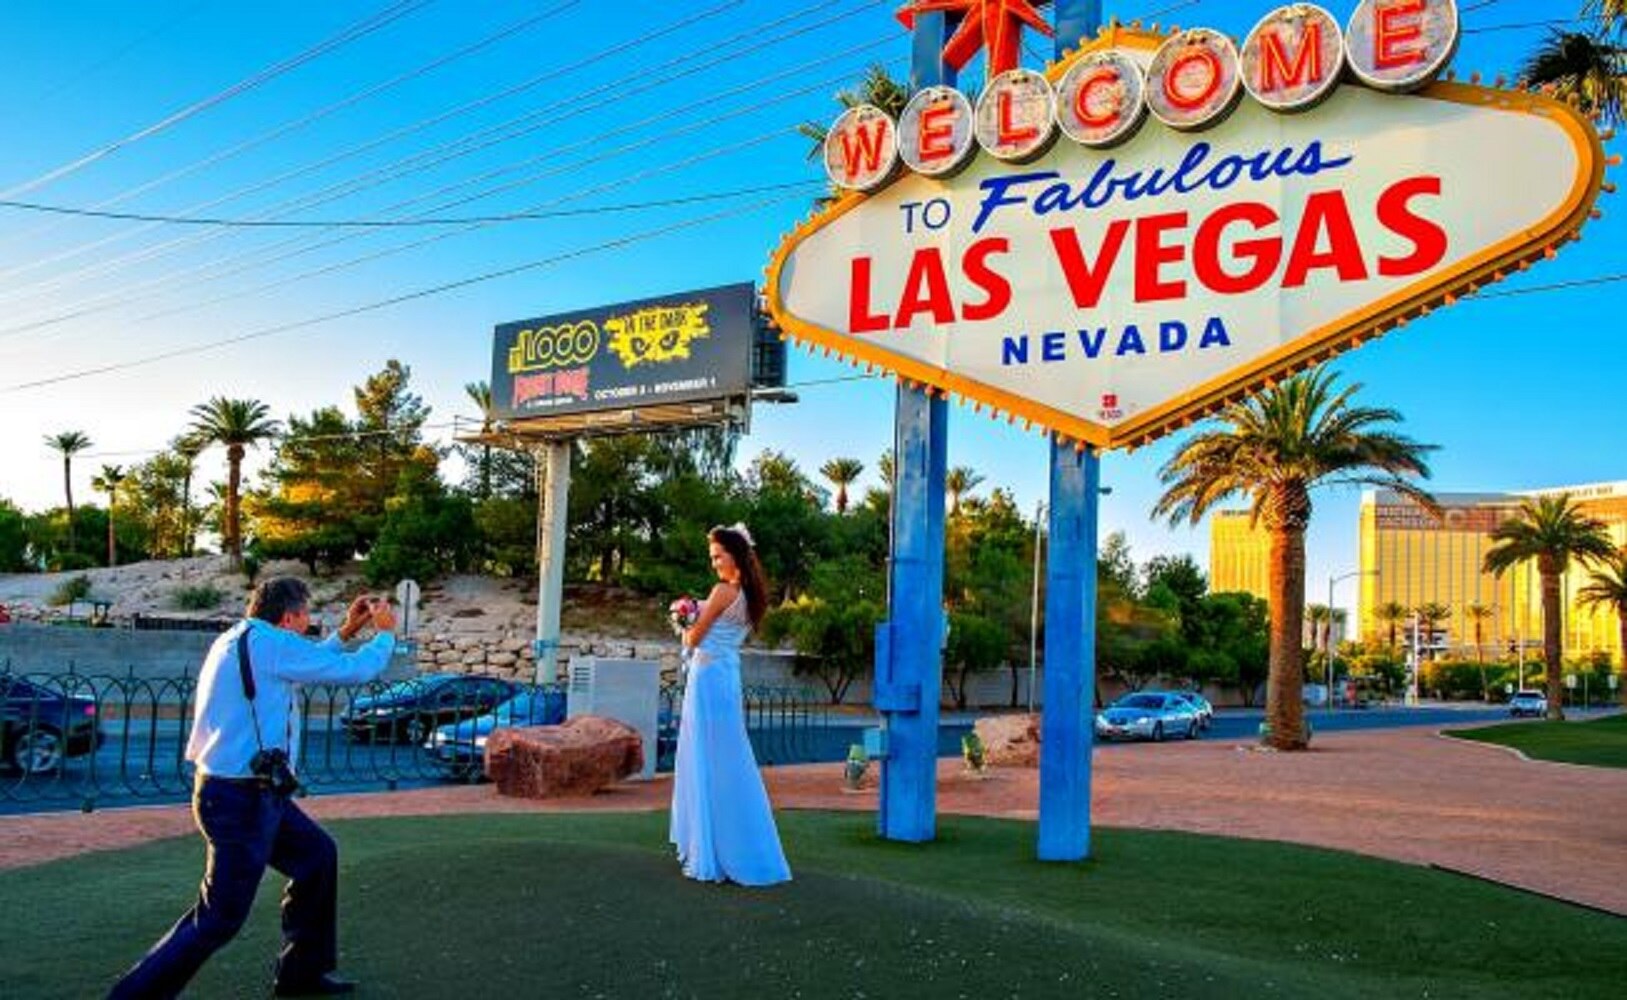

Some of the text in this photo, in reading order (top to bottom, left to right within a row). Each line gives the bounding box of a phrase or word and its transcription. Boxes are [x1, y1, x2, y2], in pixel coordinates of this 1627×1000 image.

[837, 0, 1428, 178] WELCOME
[899, 140, 1353, 234] TO Fabulous
[849, 176, 1449, 335] LAS VEGAS
[637, 310, 657, 333] THE
[660, 307, 689, 331] DARK
[1001, 316, 1231, 366] NEVADA
